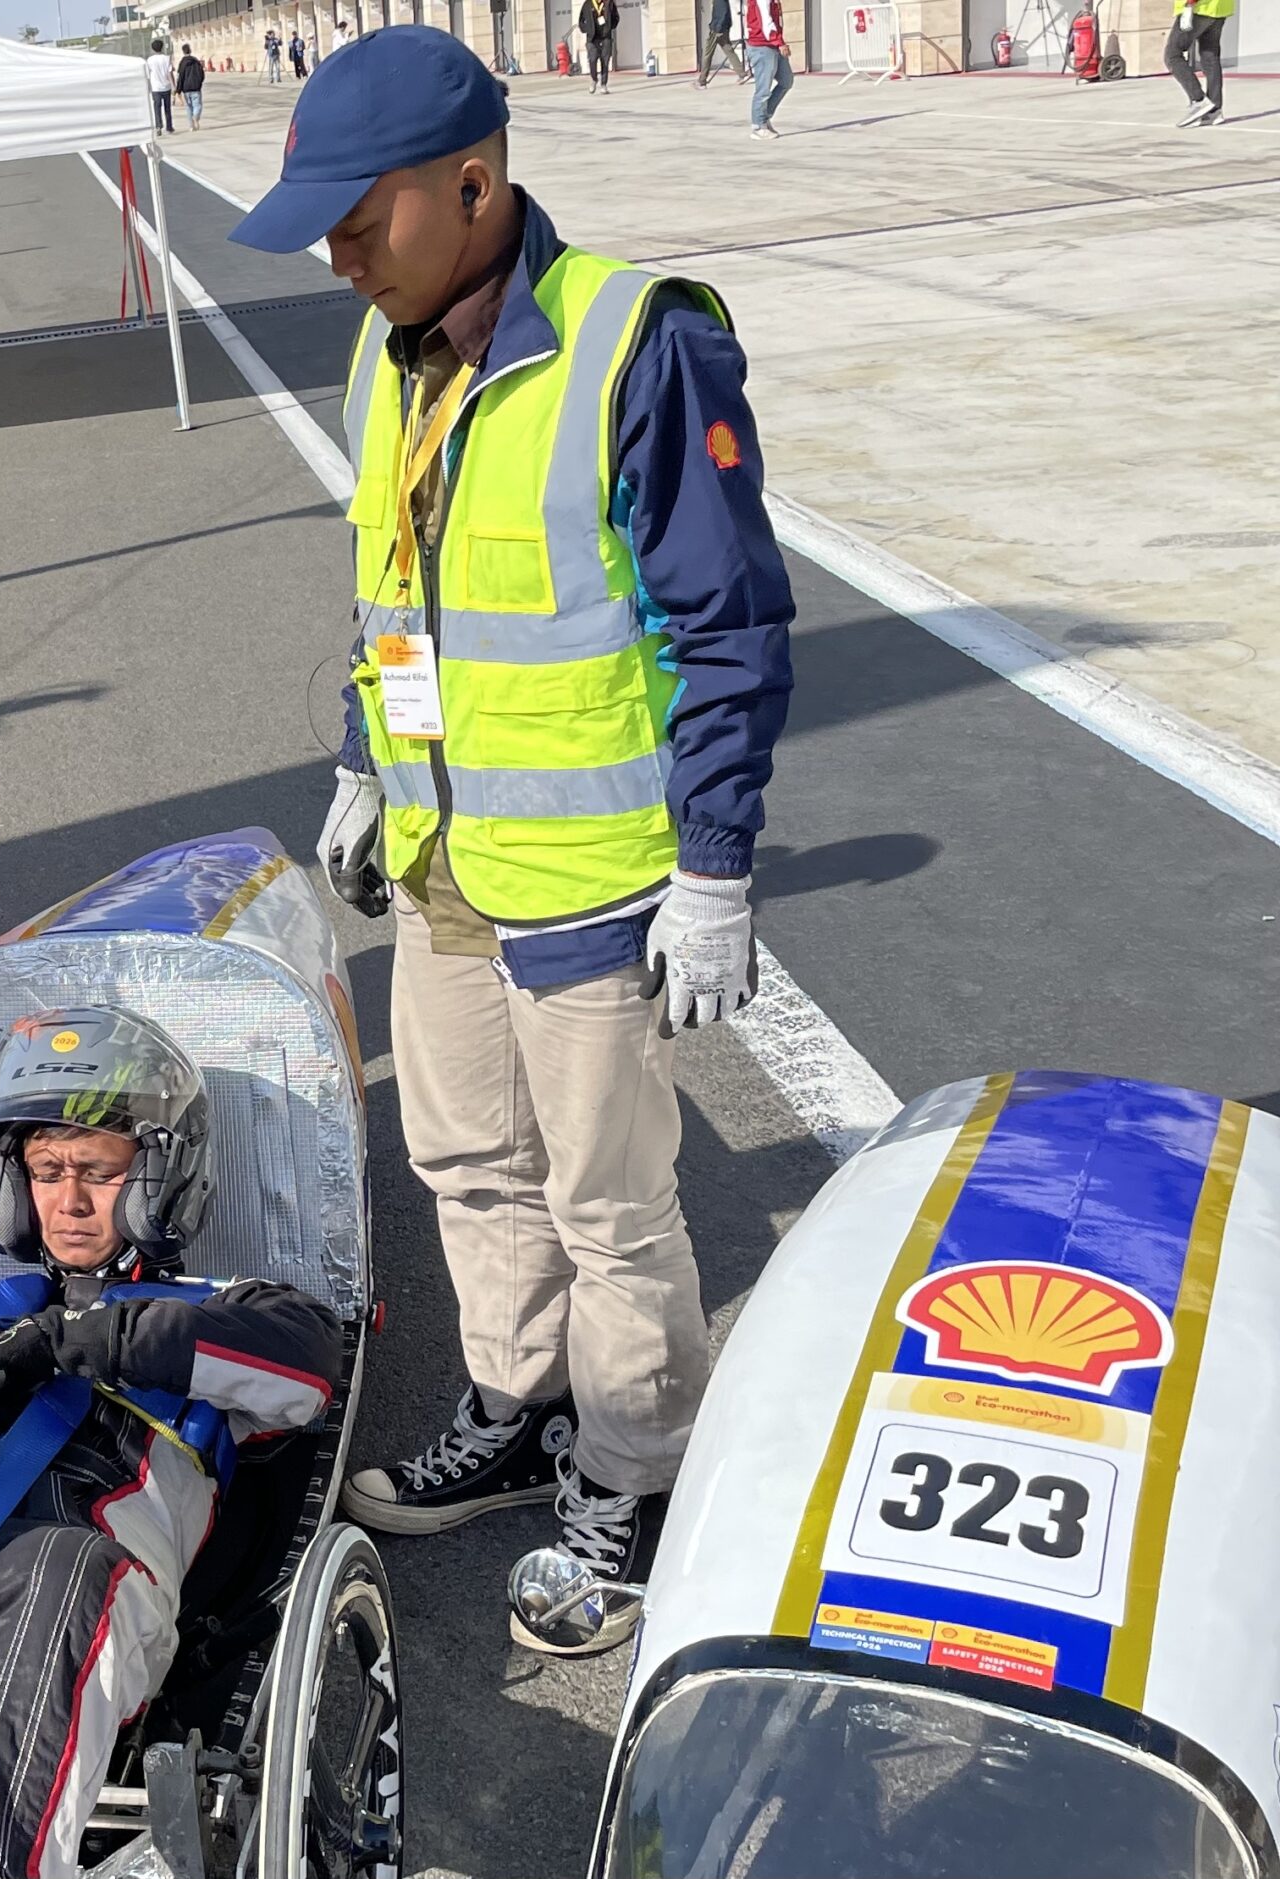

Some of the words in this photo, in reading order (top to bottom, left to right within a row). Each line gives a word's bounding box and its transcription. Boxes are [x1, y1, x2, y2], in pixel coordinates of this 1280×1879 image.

[54, 1037, 77, 1046] 2026
[11, 1062, 99, 1080] LS2
[975, 1400, 1071, 1422] Eco-marathon
[880, 1451, 1090, 1559] 323
[854, 1617, 924, 1634] Eco-marathon
[821, 1628, 867, 1642] TECHNICAL
[868, 1635, 922, 1651] INSPECTION
[973, 1636, 1046, 1660] Eco-marathon
[942, 1647, 978, 1660] SAFETY
[981, 1655, 1044, 1676] INSPECTION
[978, 1661, 1004, 1674] 2026
